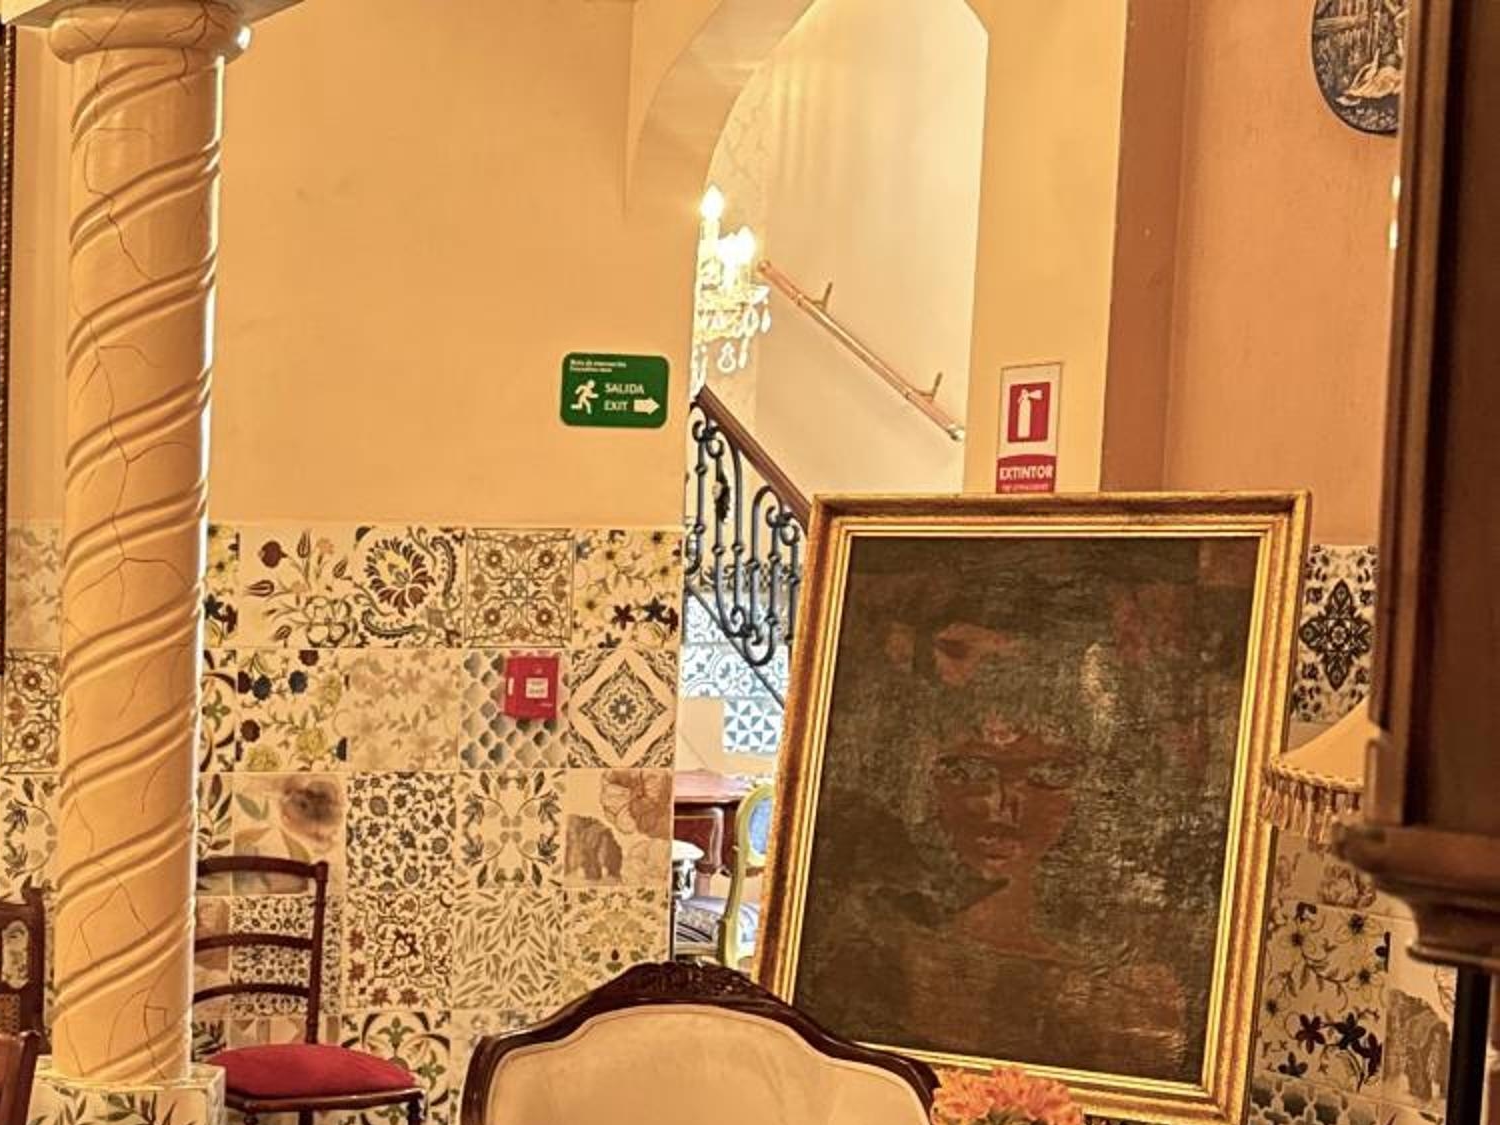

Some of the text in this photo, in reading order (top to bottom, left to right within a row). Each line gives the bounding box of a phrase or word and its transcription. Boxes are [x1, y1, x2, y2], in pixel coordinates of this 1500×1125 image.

[604, 383, 644, 394] SALIDA
[604, 400, 628, 411] EXIT
[999, 465, 1053, 480] EXTINTOR
